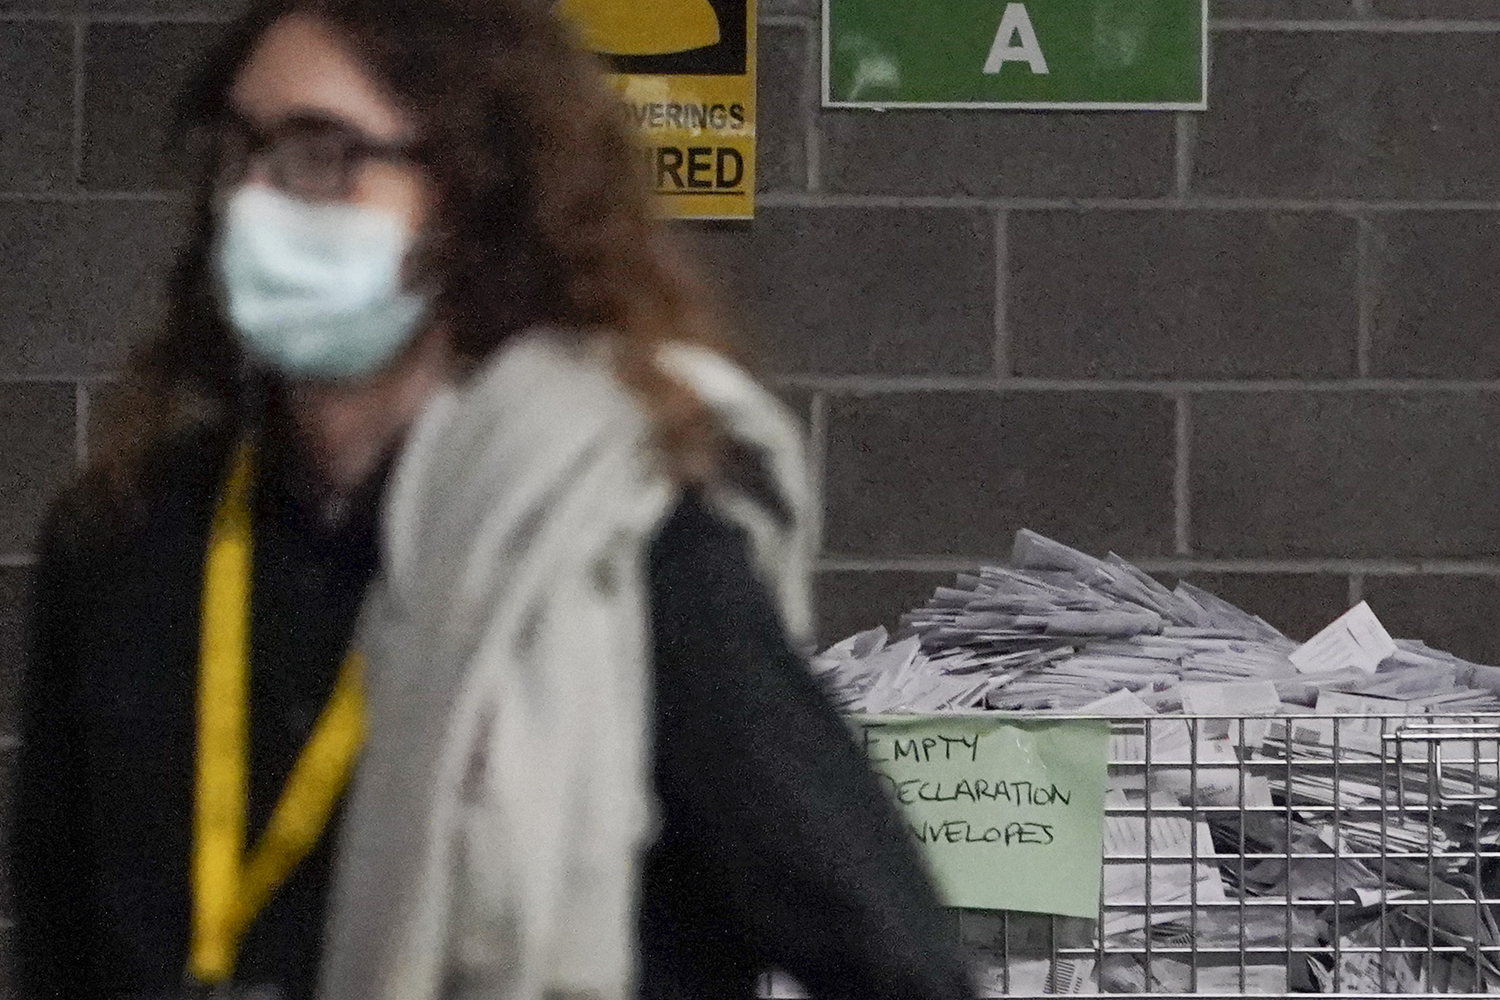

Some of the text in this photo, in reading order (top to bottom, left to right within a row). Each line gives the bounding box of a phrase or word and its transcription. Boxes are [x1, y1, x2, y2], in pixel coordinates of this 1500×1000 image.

[982, 2, 1050, 74] A
[862, 723, 980, 762] EMPTY
[908, 820, 1054, 846] NVELOPES
